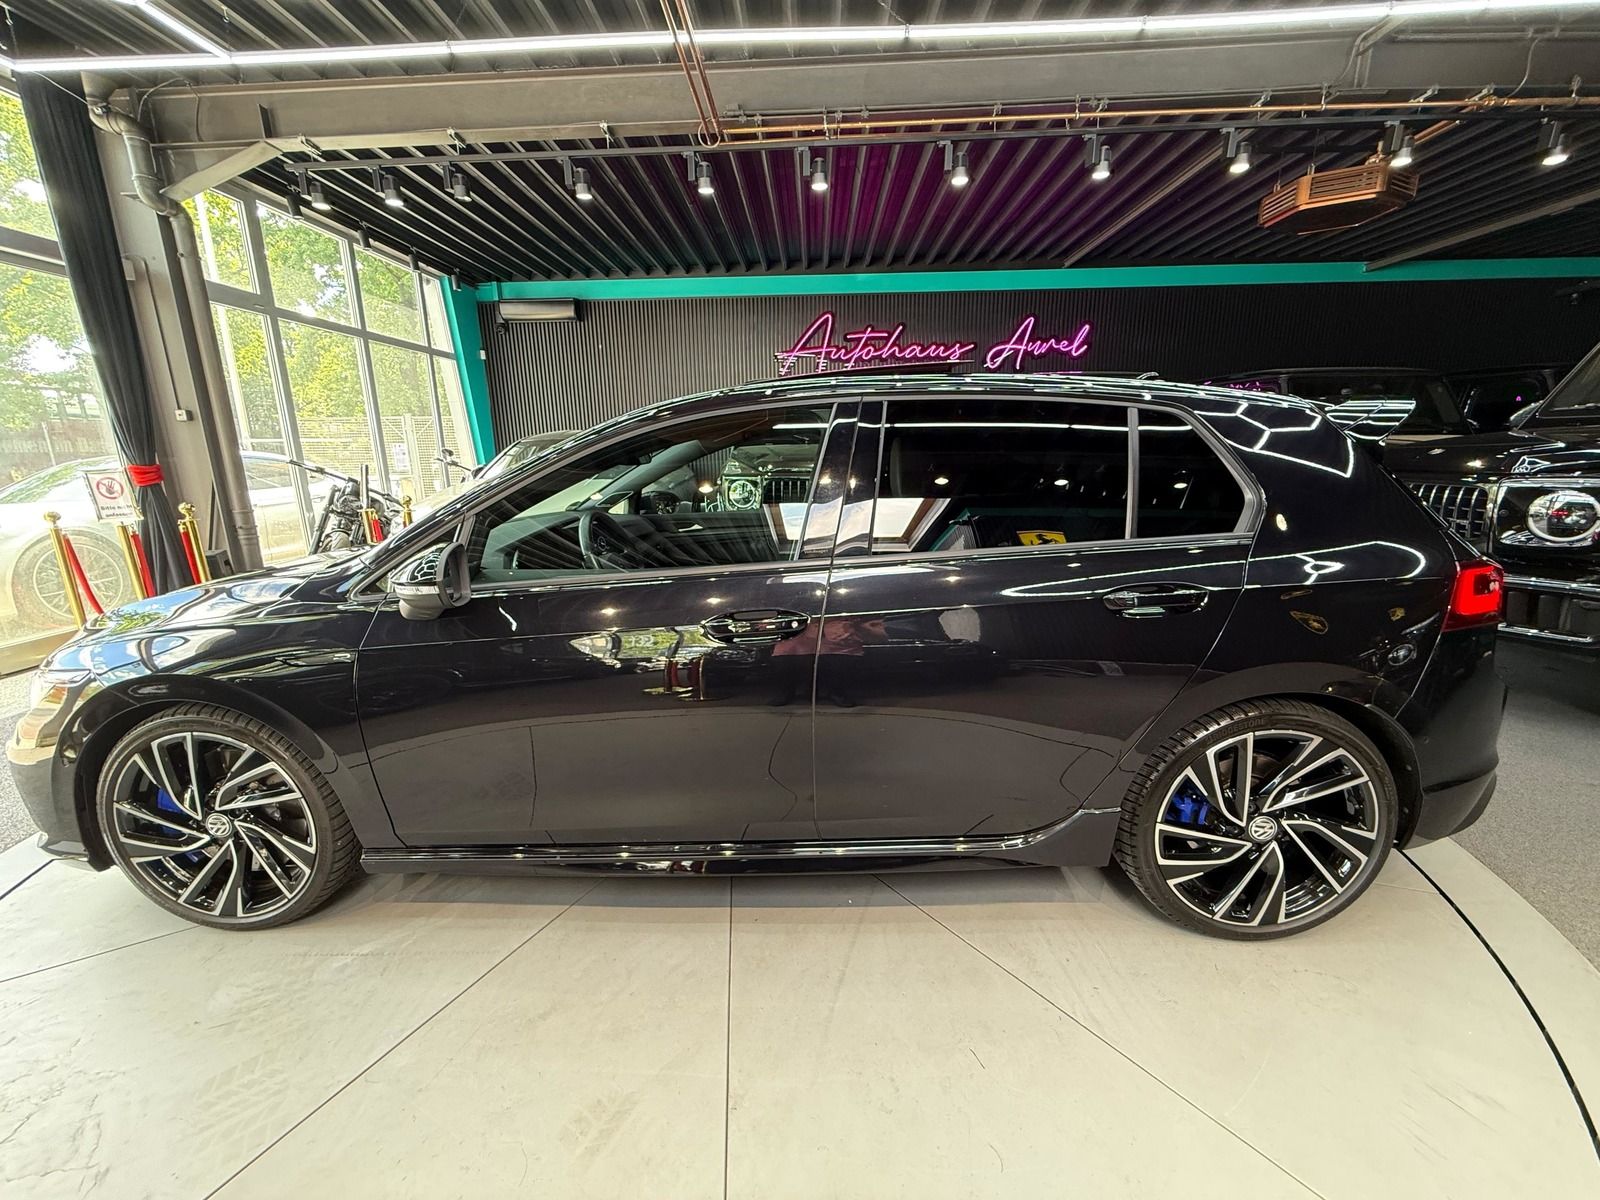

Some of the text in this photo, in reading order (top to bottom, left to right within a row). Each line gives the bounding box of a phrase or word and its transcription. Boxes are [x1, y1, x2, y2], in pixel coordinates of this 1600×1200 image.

[775, 311, 1090, 375] Autohaus Aurel
[1248, 815, 1278, 842] VW
